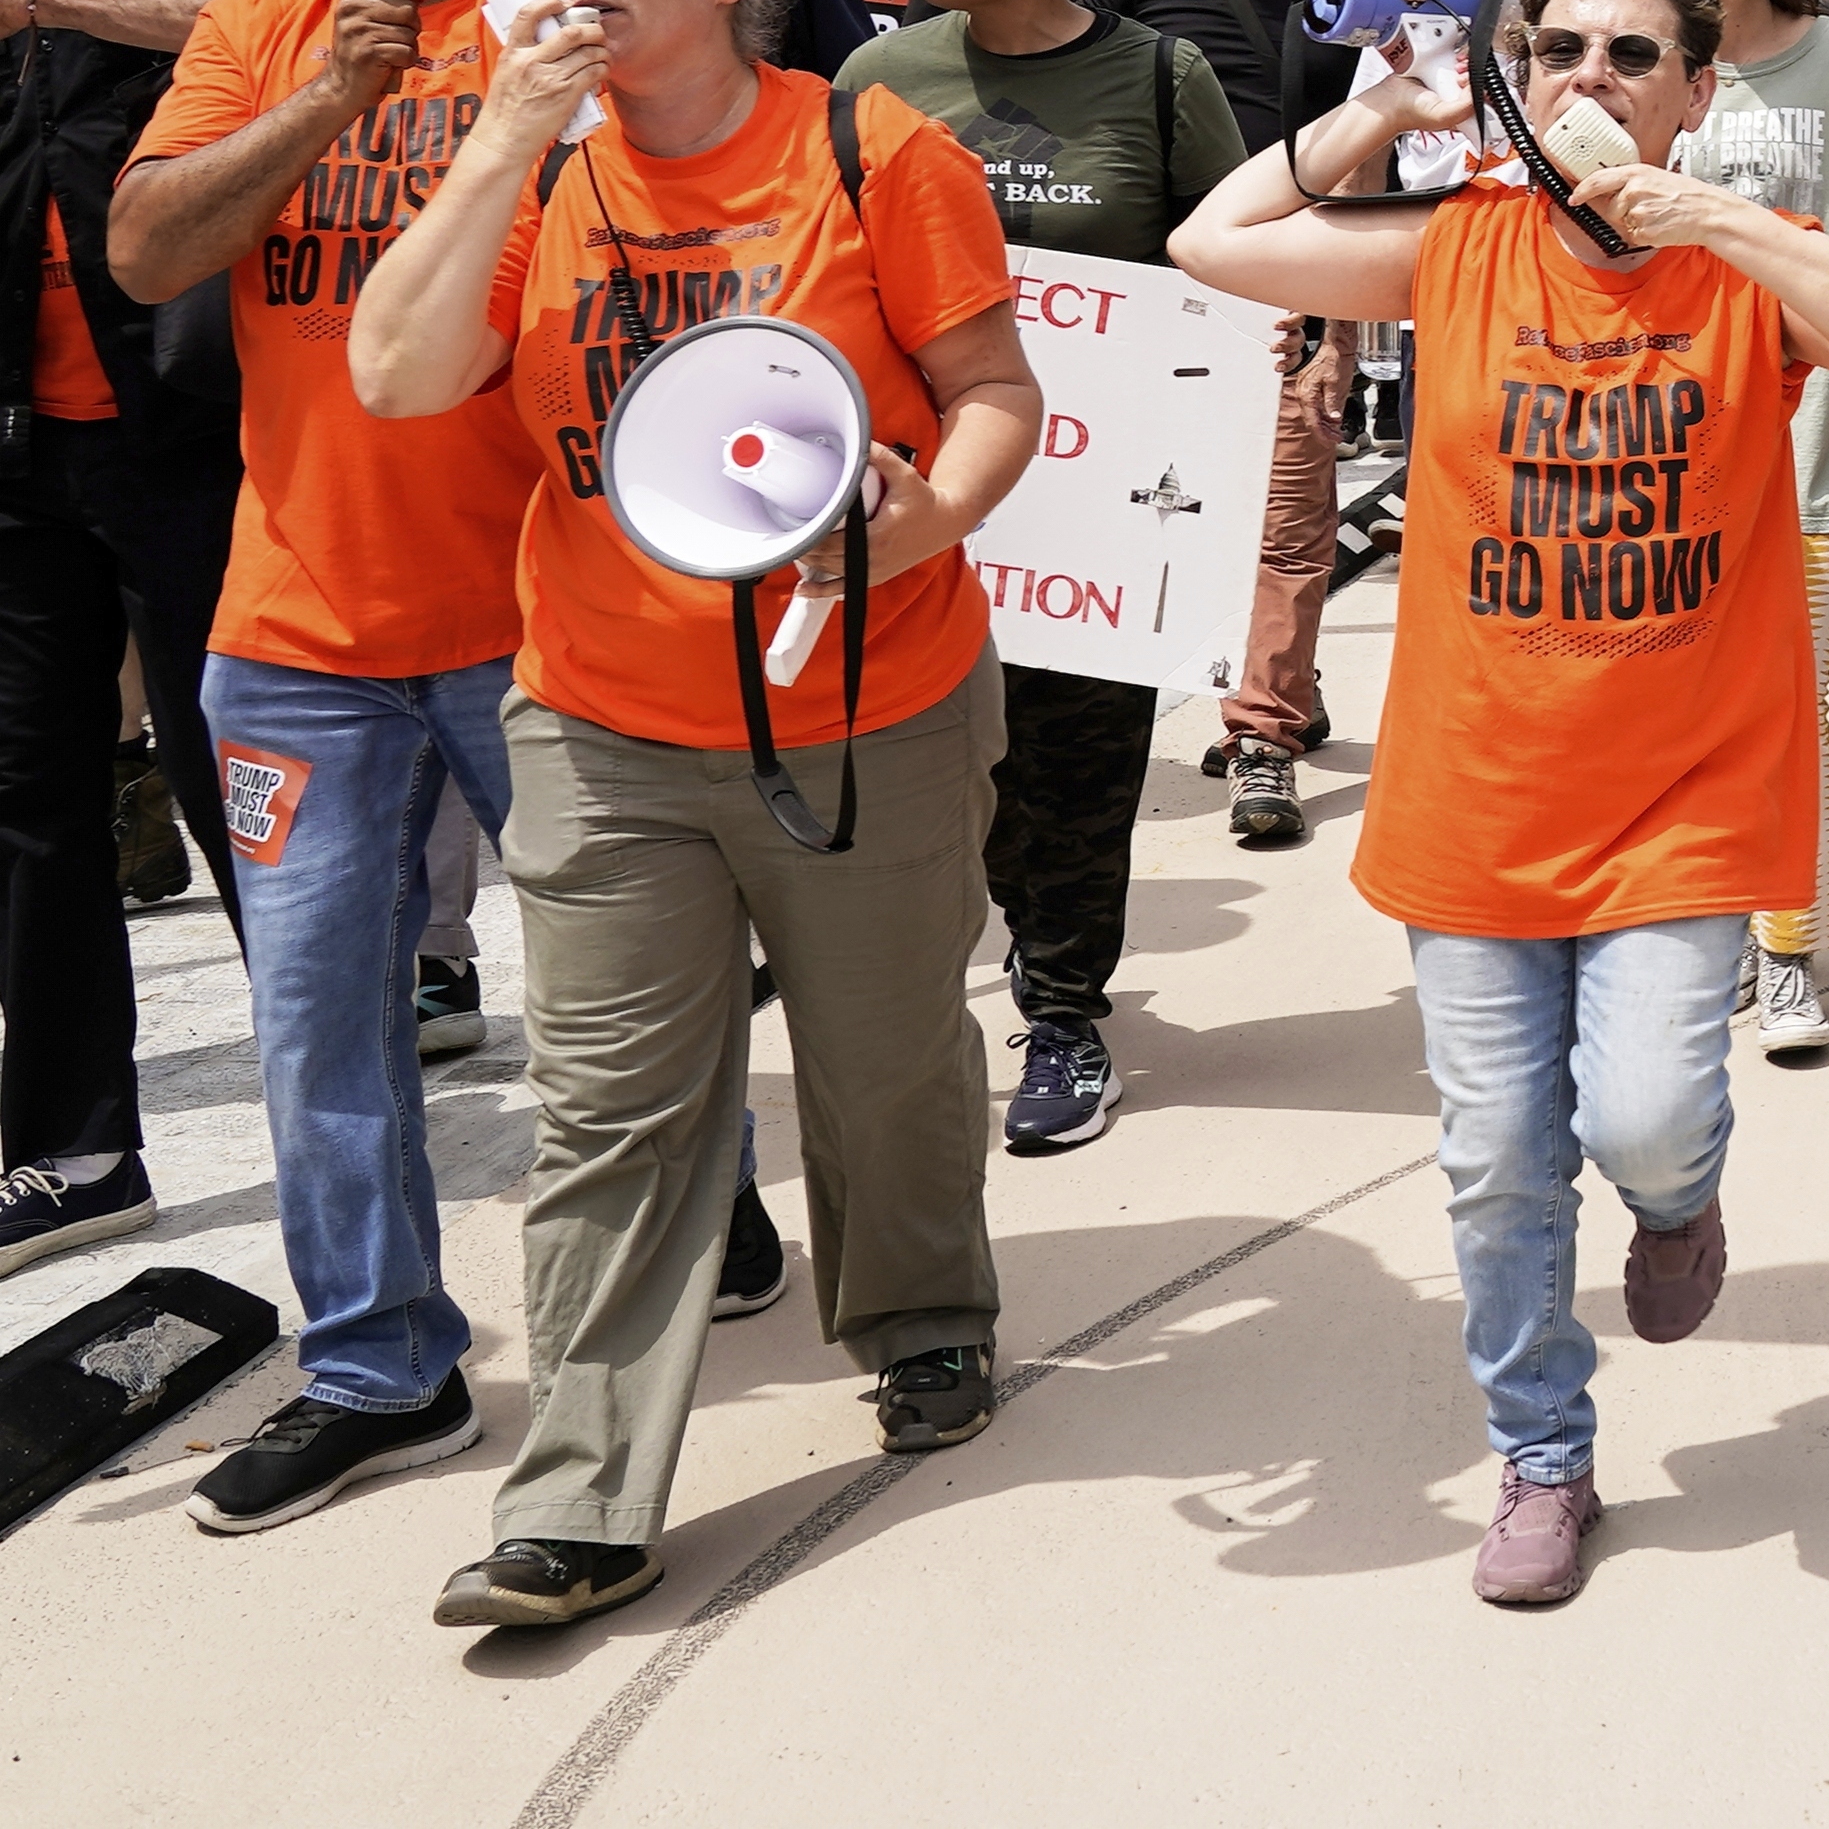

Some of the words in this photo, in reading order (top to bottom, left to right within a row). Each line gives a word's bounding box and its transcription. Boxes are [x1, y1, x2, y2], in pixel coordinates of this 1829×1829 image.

[1720, 106, 1826, 146] BREATHE
[302, 161, 450, 233] MUS
[1004, 182, 1102, 205] BACK.
[263, 233, 322, 306] GO
[1497, 378, 1706, 461] TRUMP
[1509, 458, 1690, 539] MUST
[974, 561, 1123, 630] TION
[1468, 536, 1543, 620] GO
[1560, 530, 1722, 621] NOW!
[229, 760, 281, 793] TRUMP
